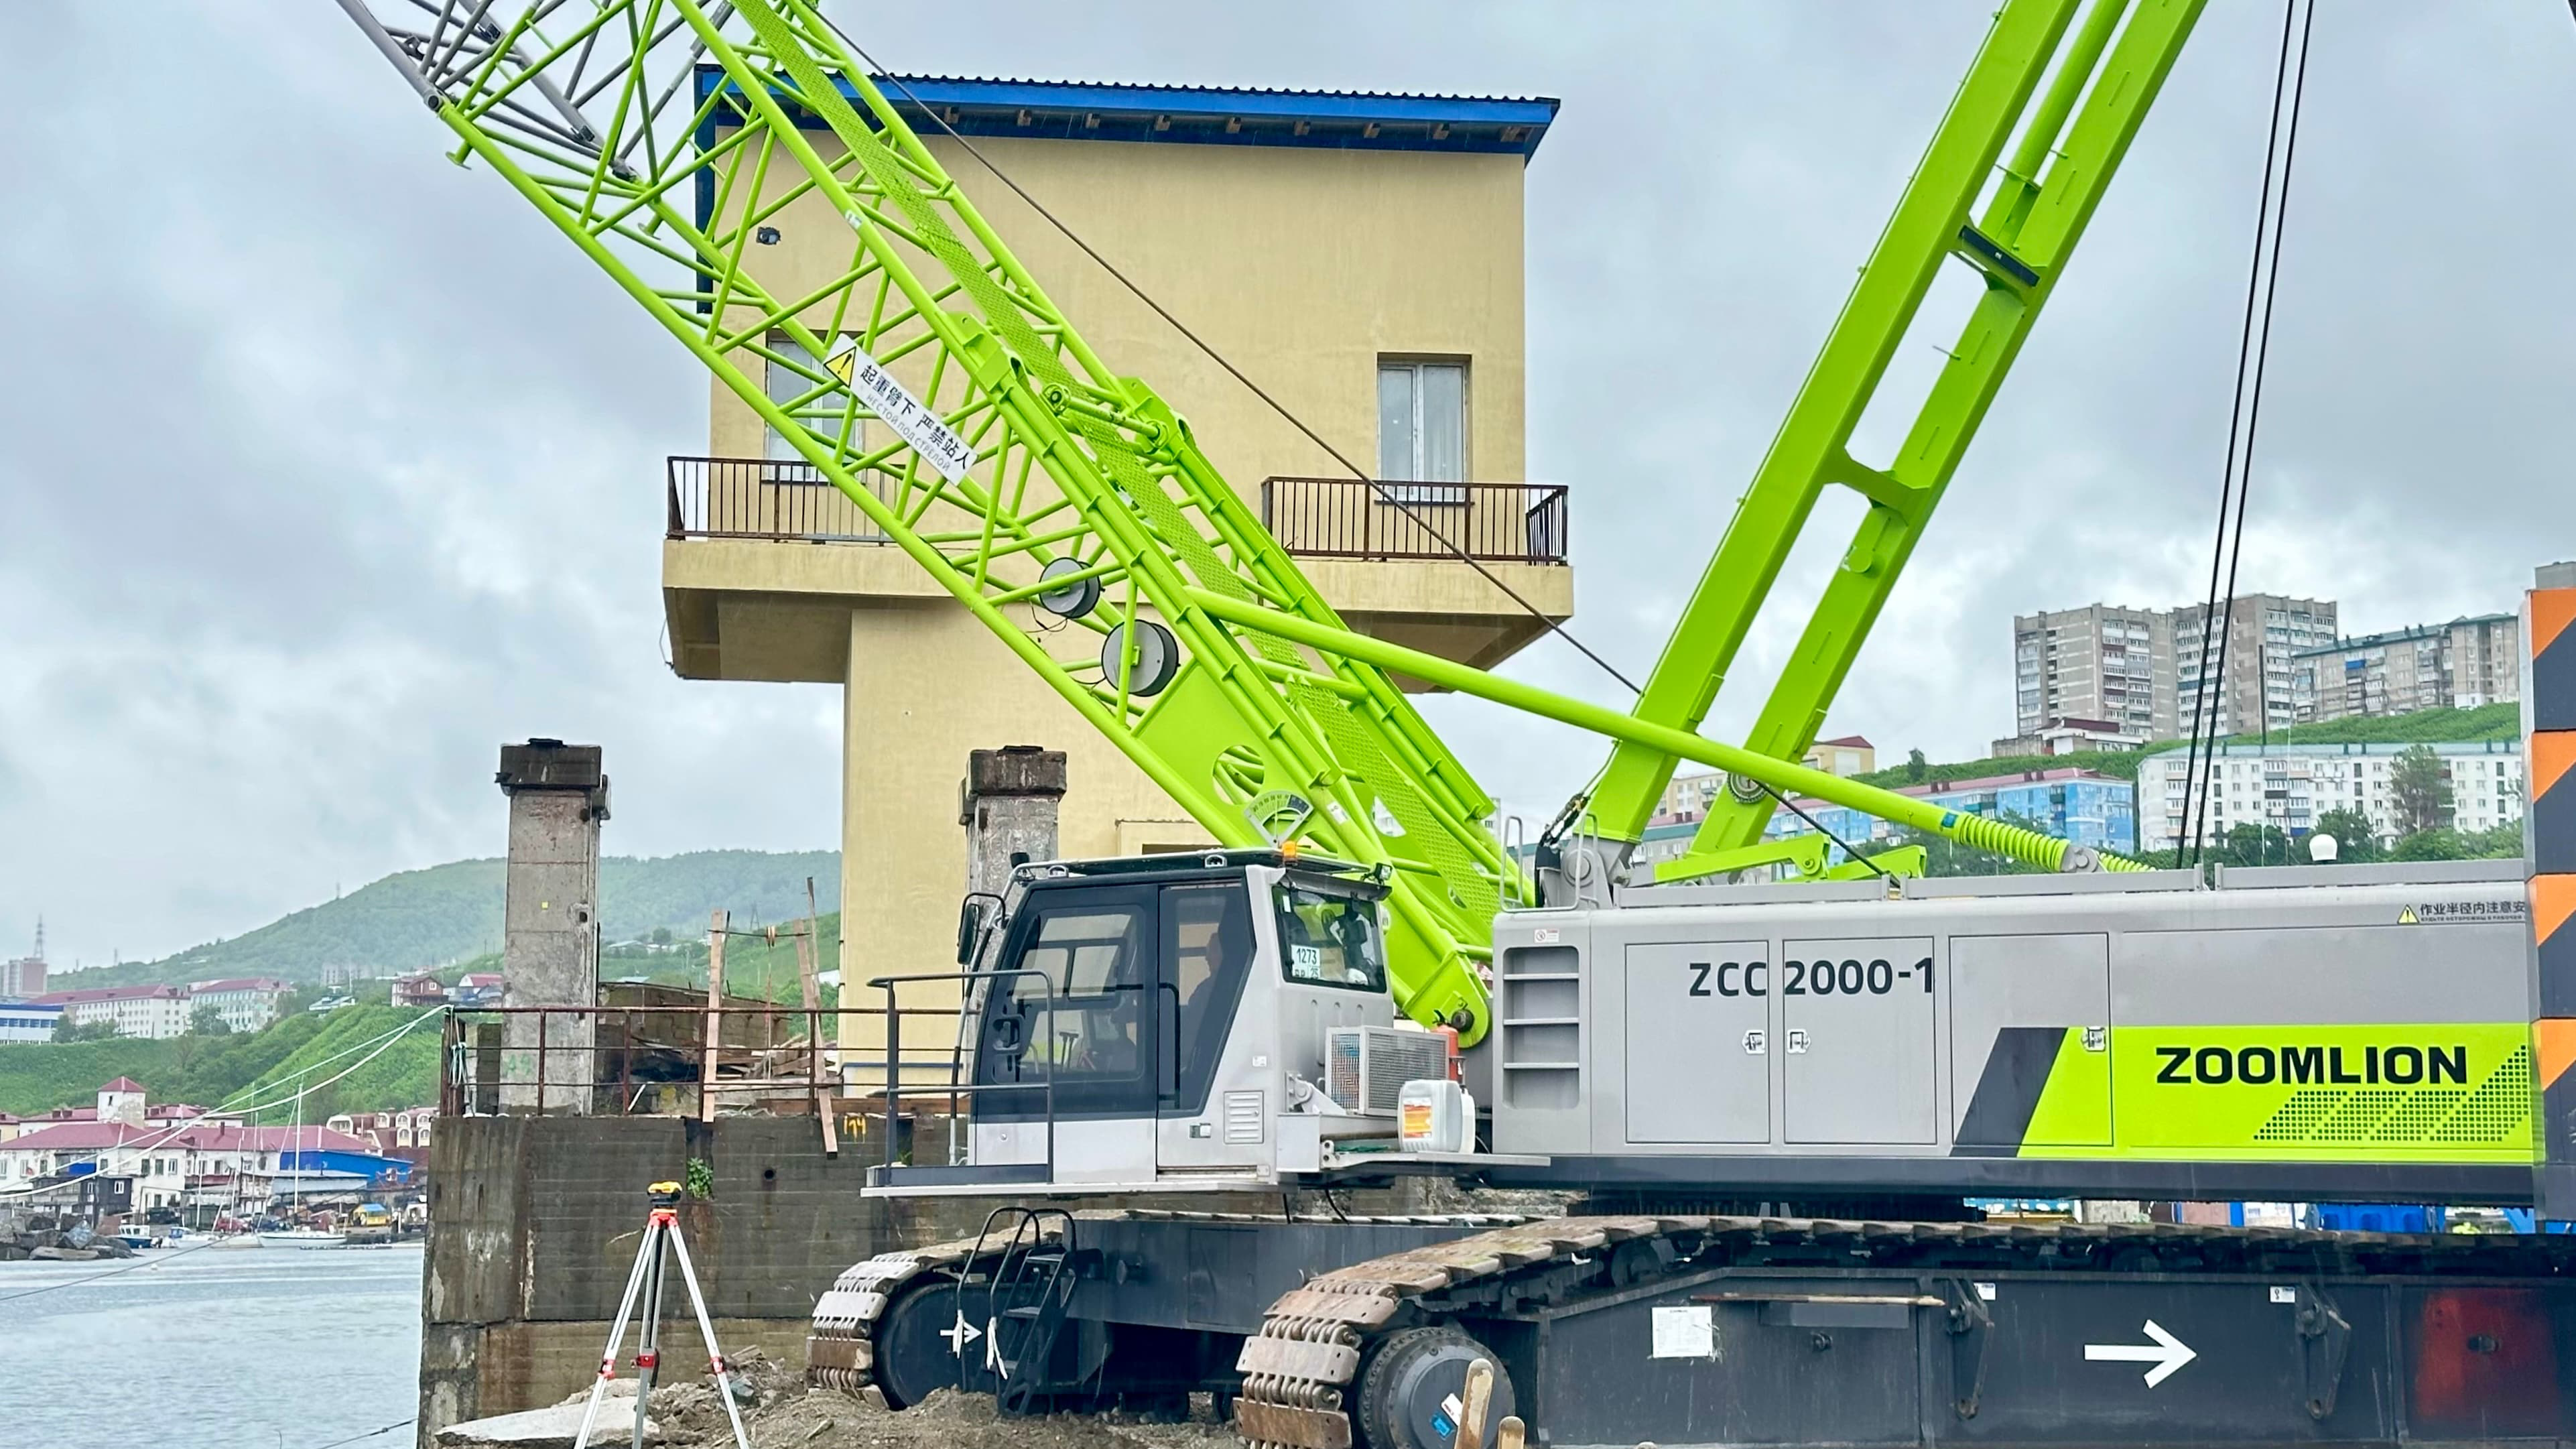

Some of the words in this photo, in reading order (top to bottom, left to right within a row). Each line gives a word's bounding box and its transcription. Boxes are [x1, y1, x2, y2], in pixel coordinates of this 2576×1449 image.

[860, 365, 916, 416] 起重臂下
[915, 413, 970, 470] 严禁站人
[897, 422, 915, 442] ПОД
[914, 437, 951, 472] СТРЕЛОЙ
[2421, 901, 2525, 916] 作业半径内注意安
[1297, 948, 1317, 964] 1273
[2155, 1046, 2467, 1084] ZOOMLION
